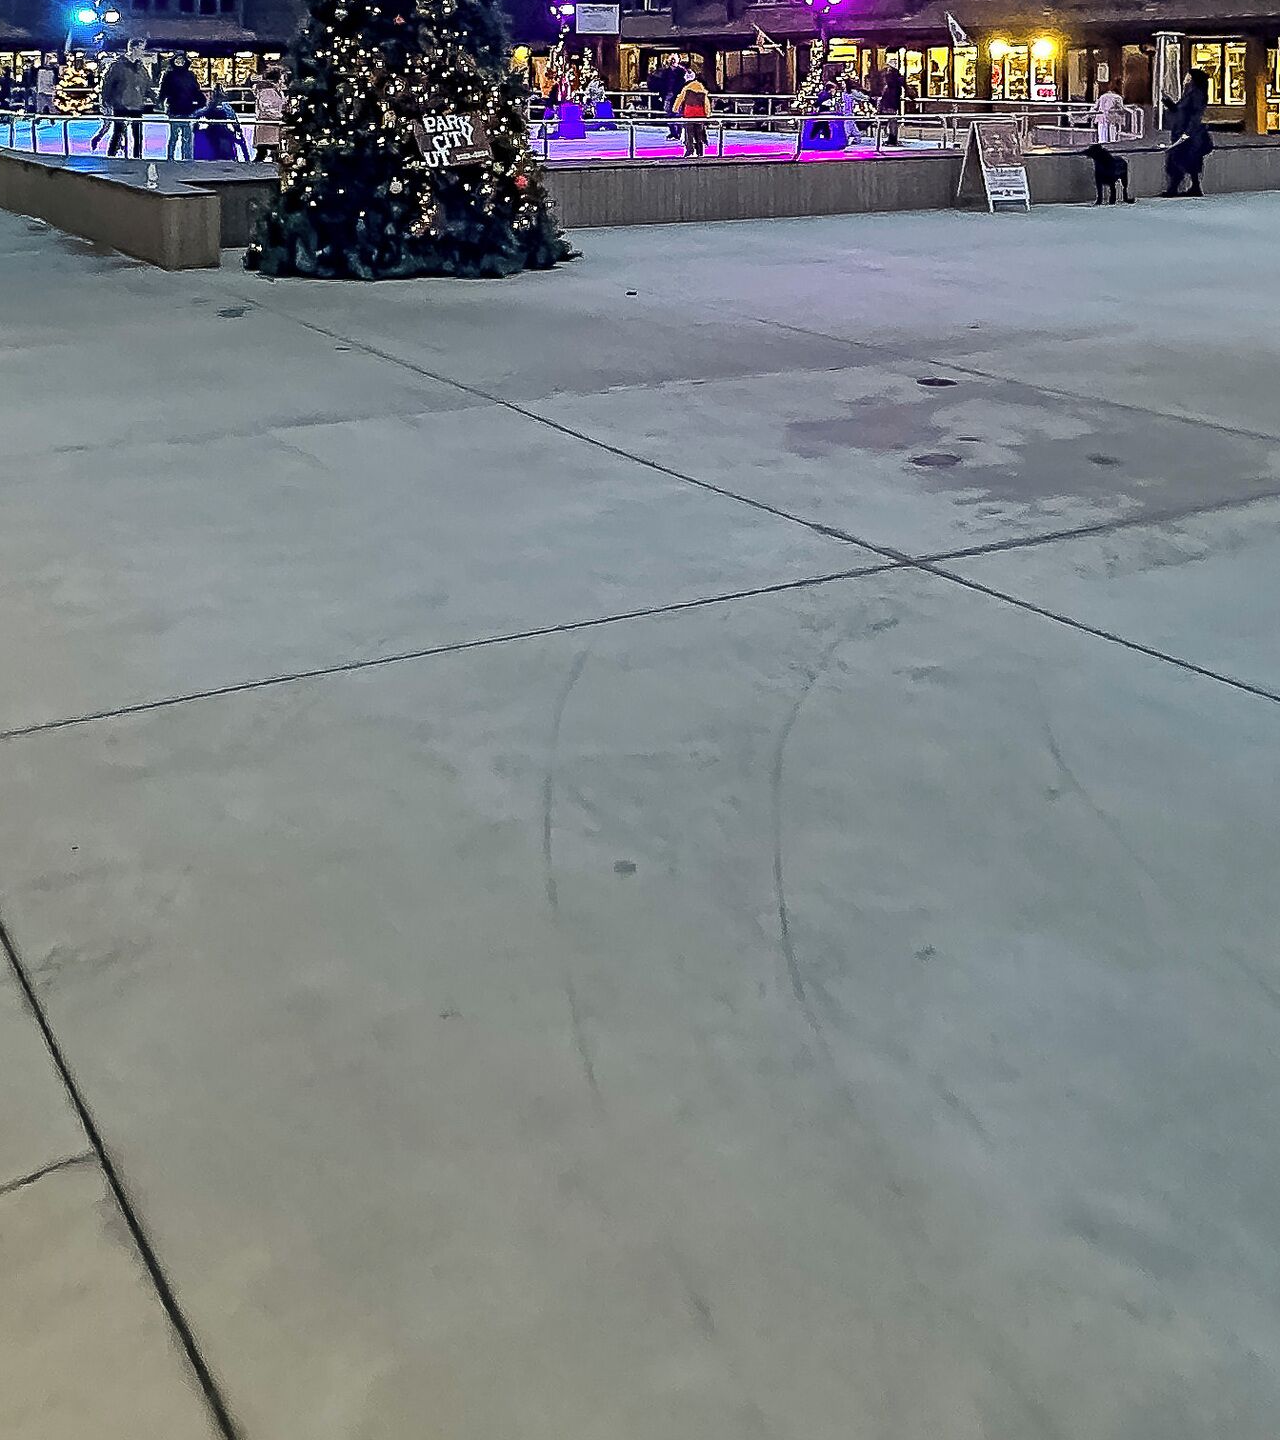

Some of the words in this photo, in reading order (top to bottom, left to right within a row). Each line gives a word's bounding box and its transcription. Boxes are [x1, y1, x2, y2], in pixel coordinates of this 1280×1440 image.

[423, 114, 472, 133] PARK
[432, 129, 474, 150] CITY
[423, 150, 450, 168] UT
